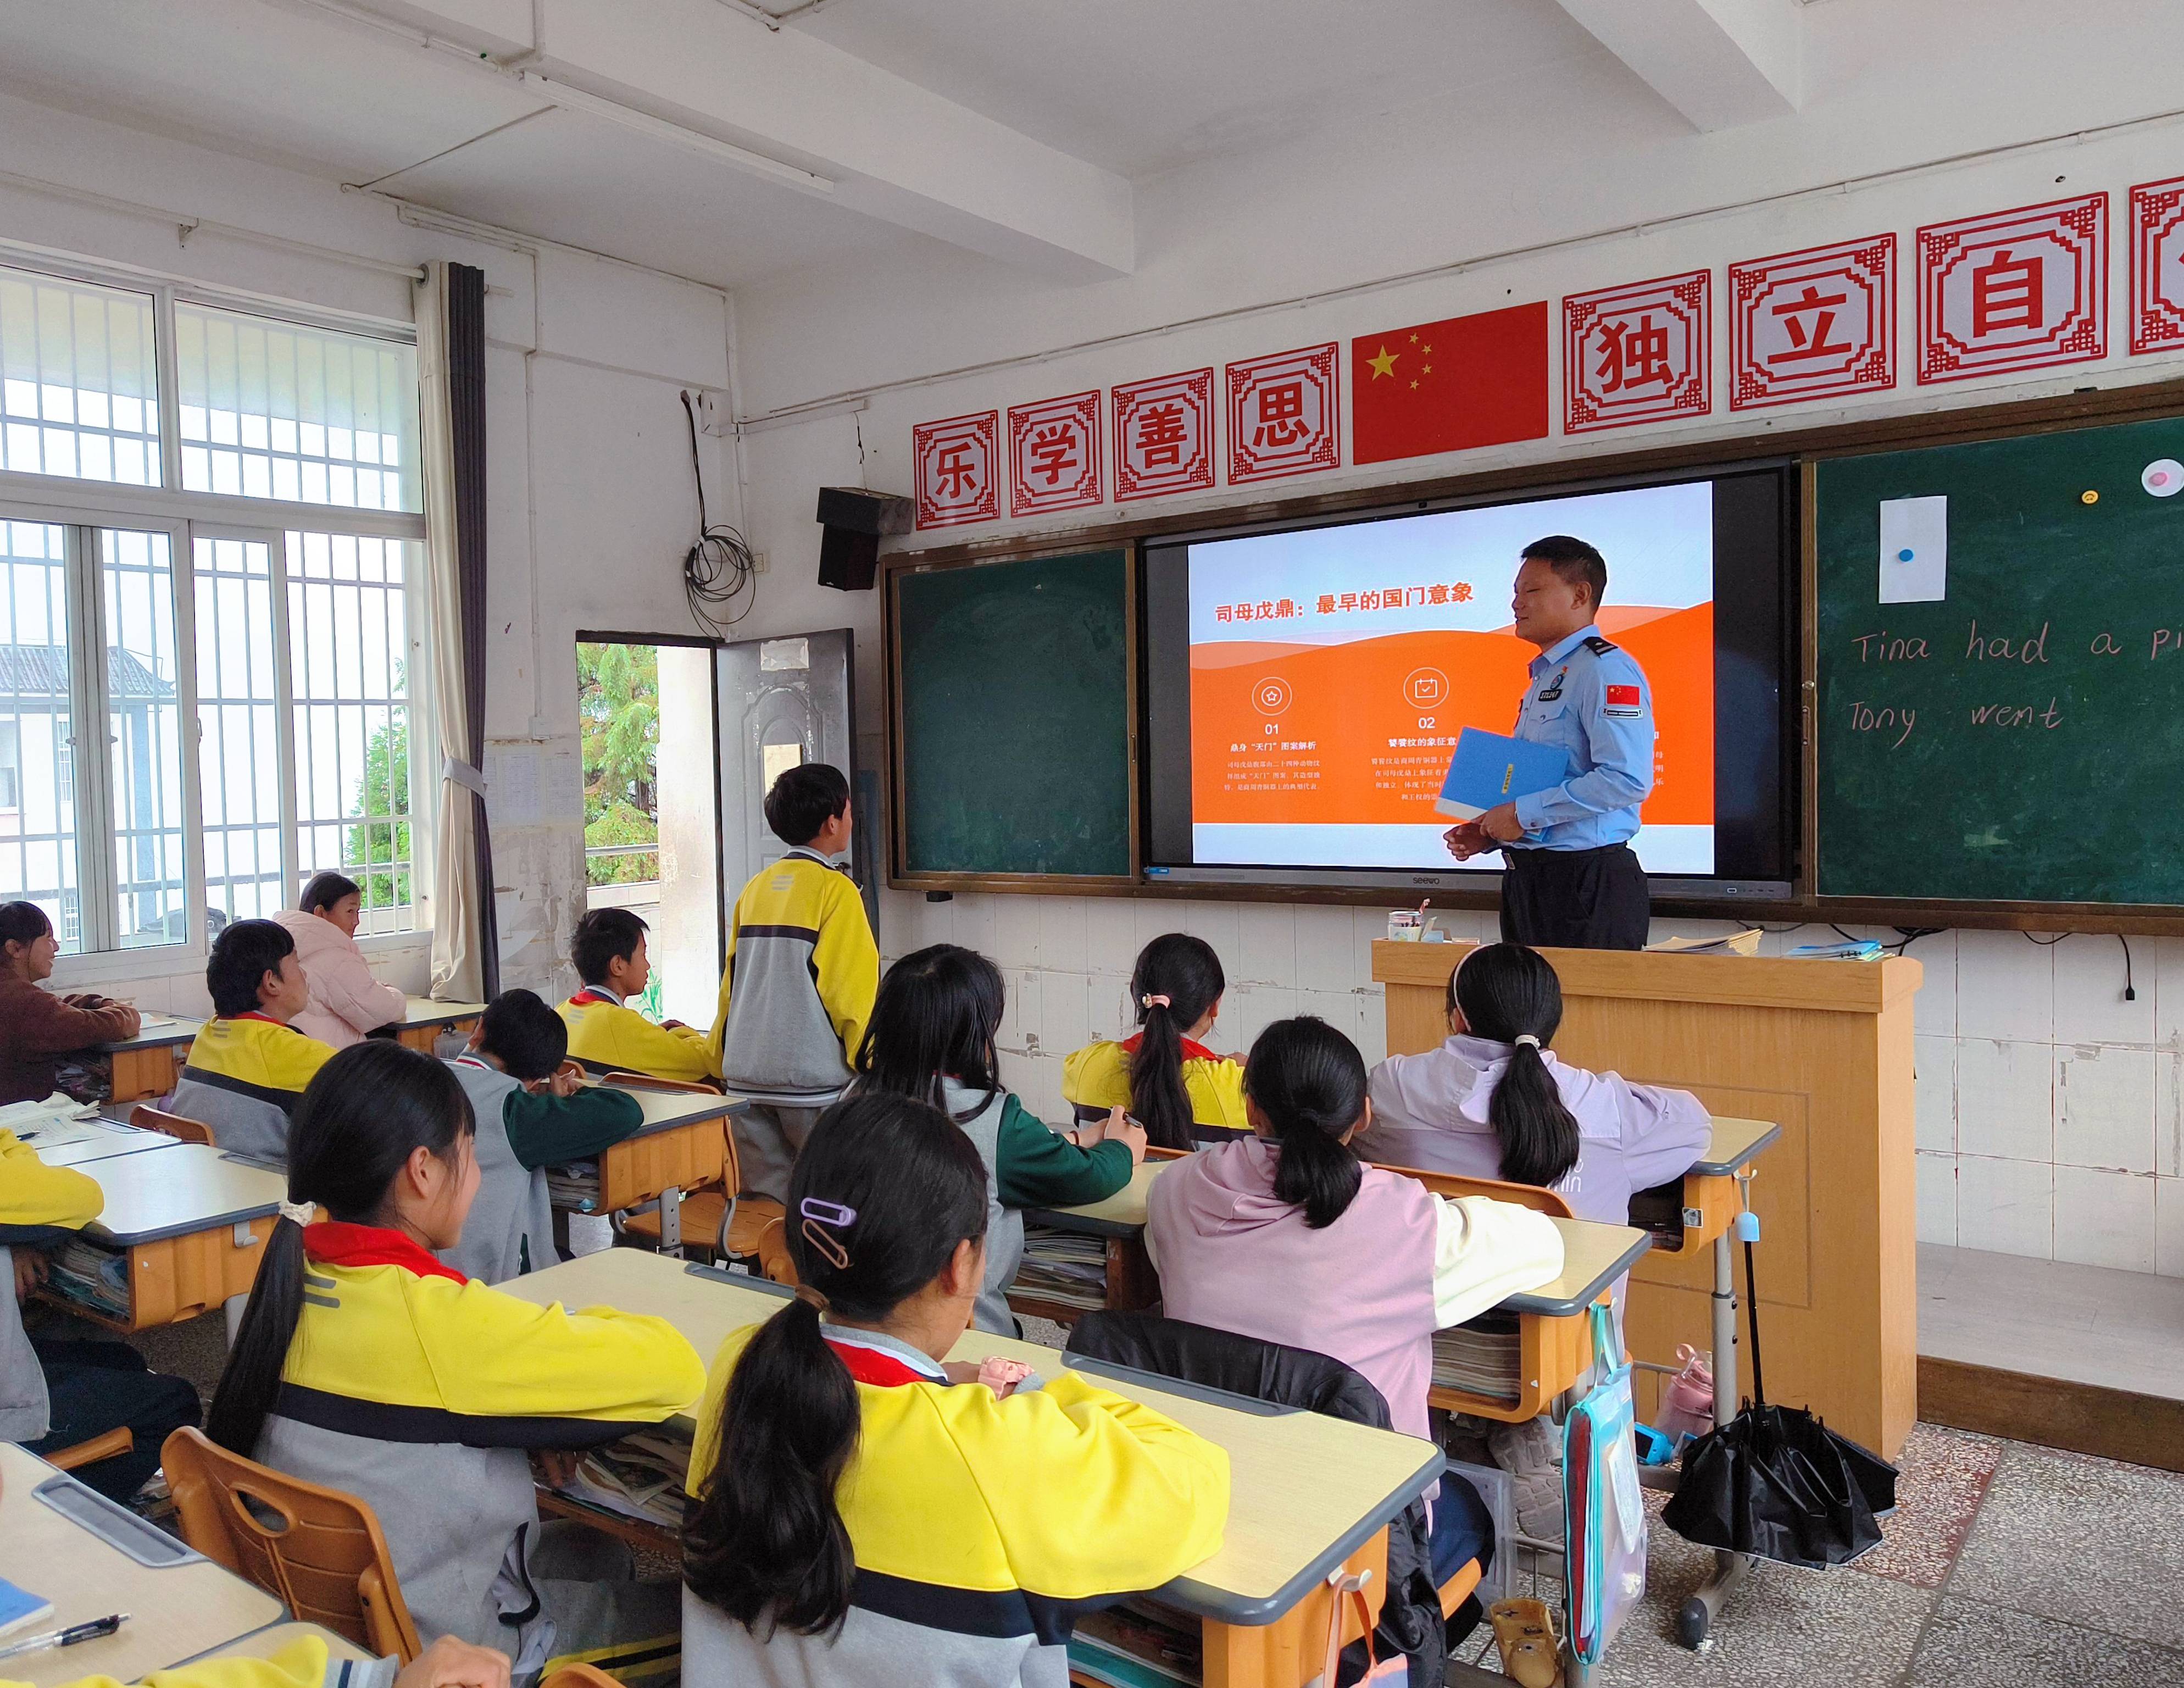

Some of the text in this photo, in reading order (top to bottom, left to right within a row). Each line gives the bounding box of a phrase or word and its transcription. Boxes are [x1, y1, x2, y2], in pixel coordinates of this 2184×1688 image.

[1215, 581, 1474, 623] 司母戊鼎：最早的国门意象
[1852, 630, 1930, 662] Tina
[1965, 619, 2049, 664] had
[2091, 632, 2122, 656] a
[1265, 723, 1279, 735] 01
[1418, 717, 1436, 729] 02
[1849, 697, 2064, 750] Tony went
